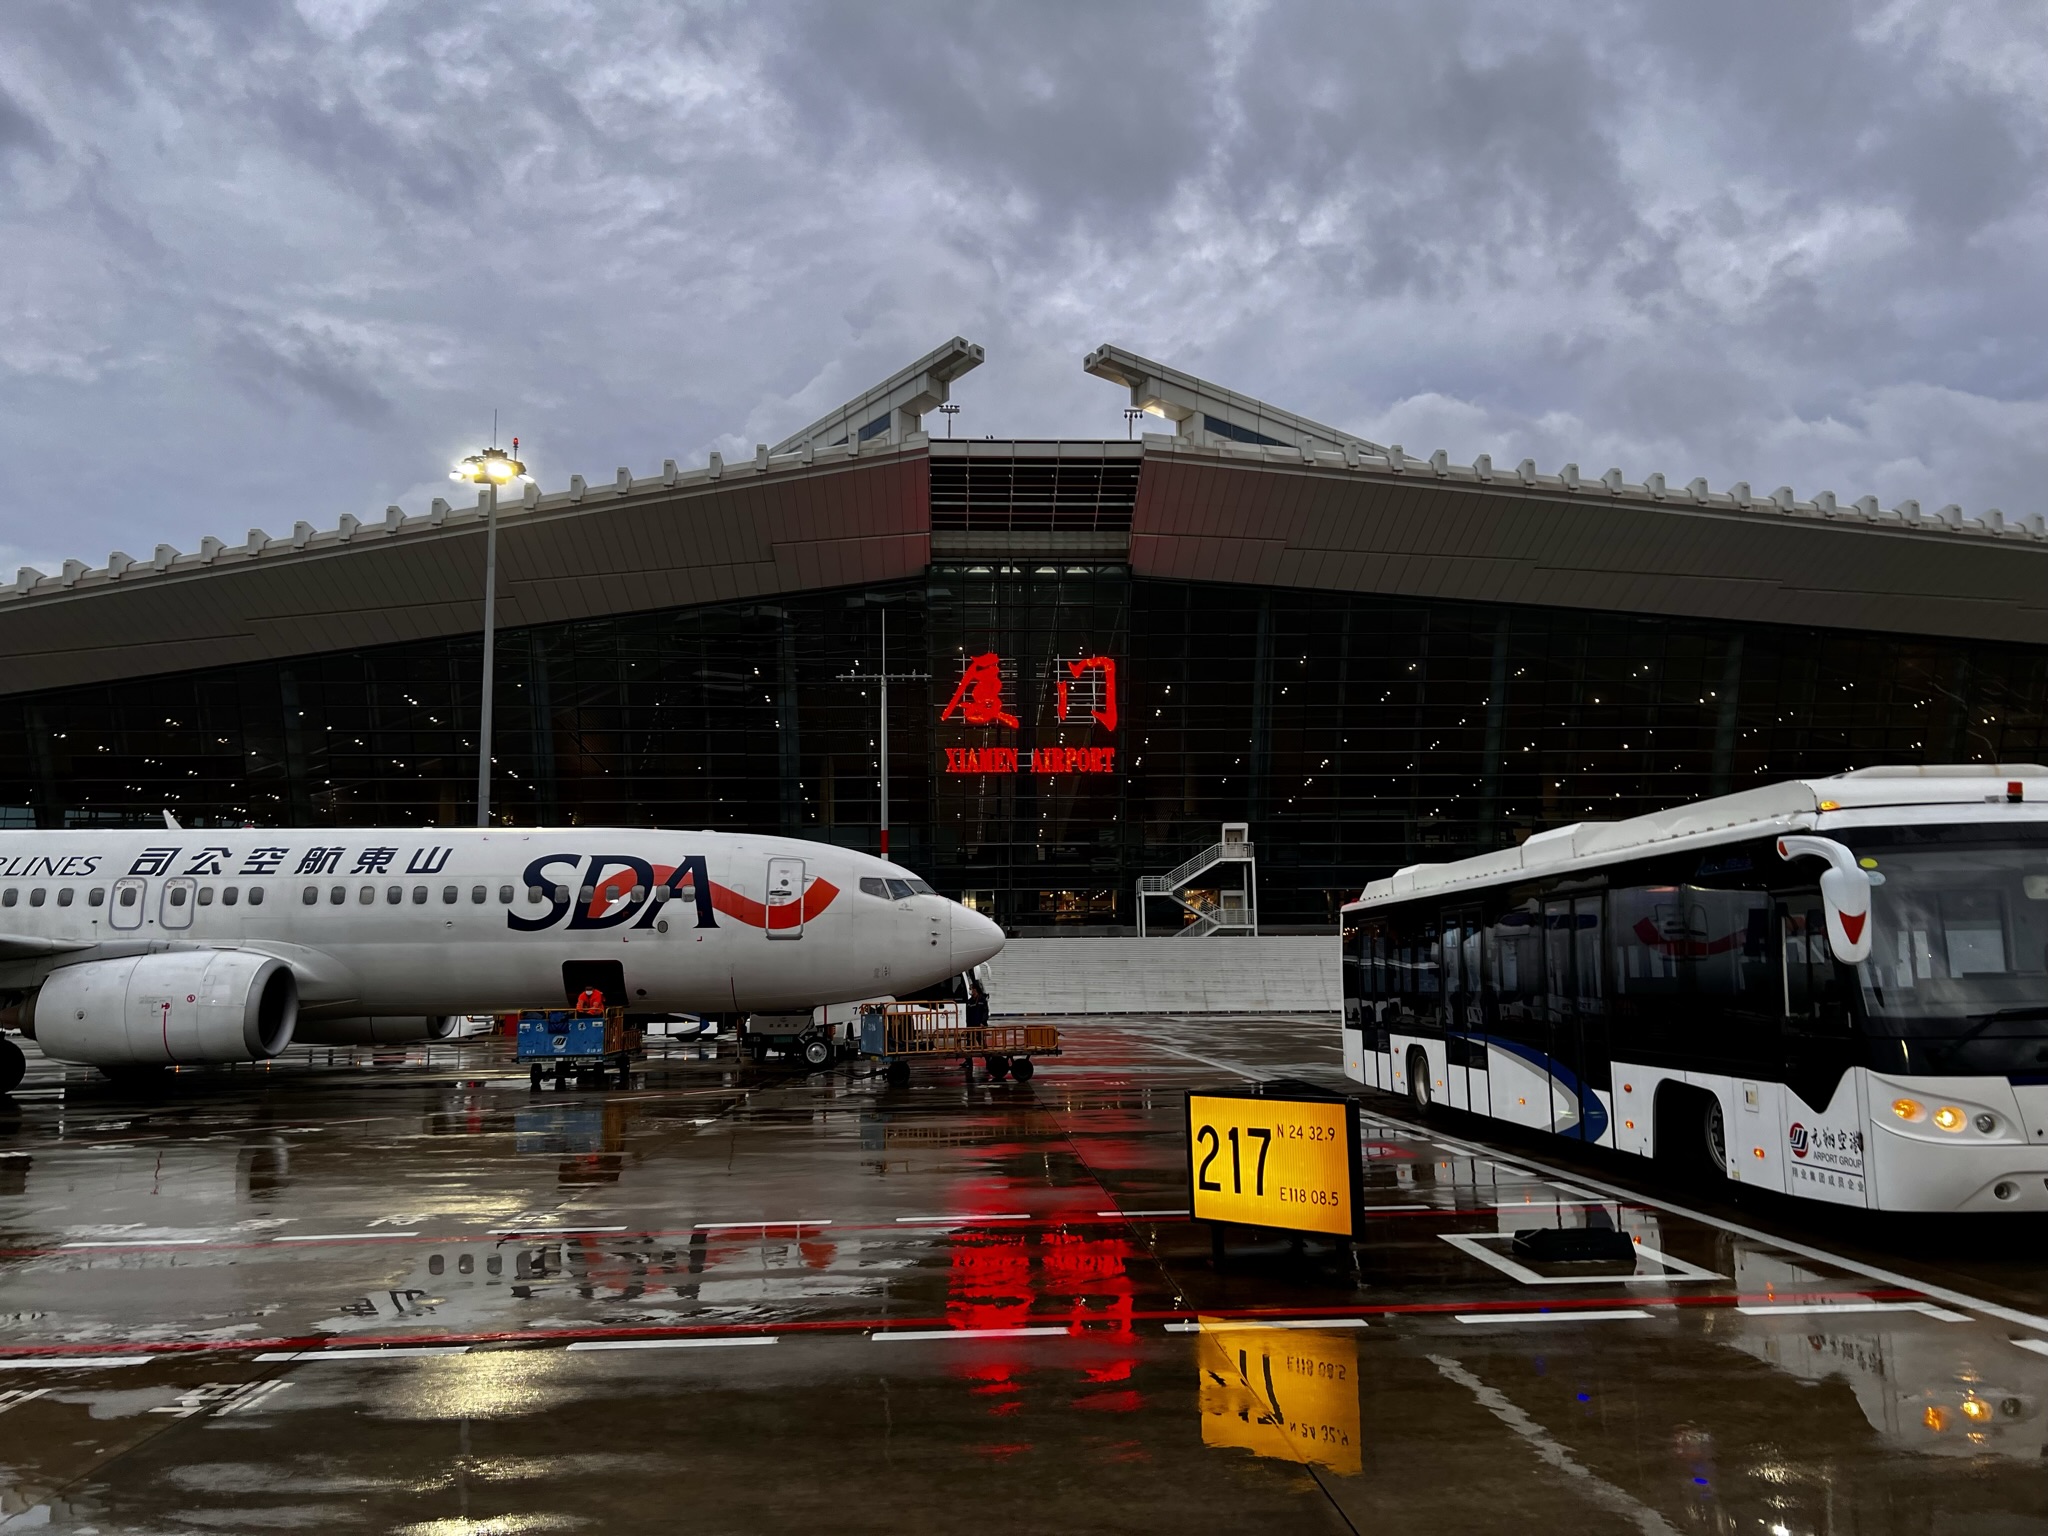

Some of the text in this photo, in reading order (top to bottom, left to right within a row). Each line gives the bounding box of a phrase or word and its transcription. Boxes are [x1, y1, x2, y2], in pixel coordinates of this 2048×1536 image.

[945, 747, 1115, 773] XIAMEN AIRPORT
[507, 853, 721, 931] SDA
[1277, 1123, 1335, 1141] N 24 32.9
[1197, 1124, 1272, 1197] 217
[1838, 1155, 1862, 1168] GROUP
[1311, 1191, 1339, 1206] 08.5
